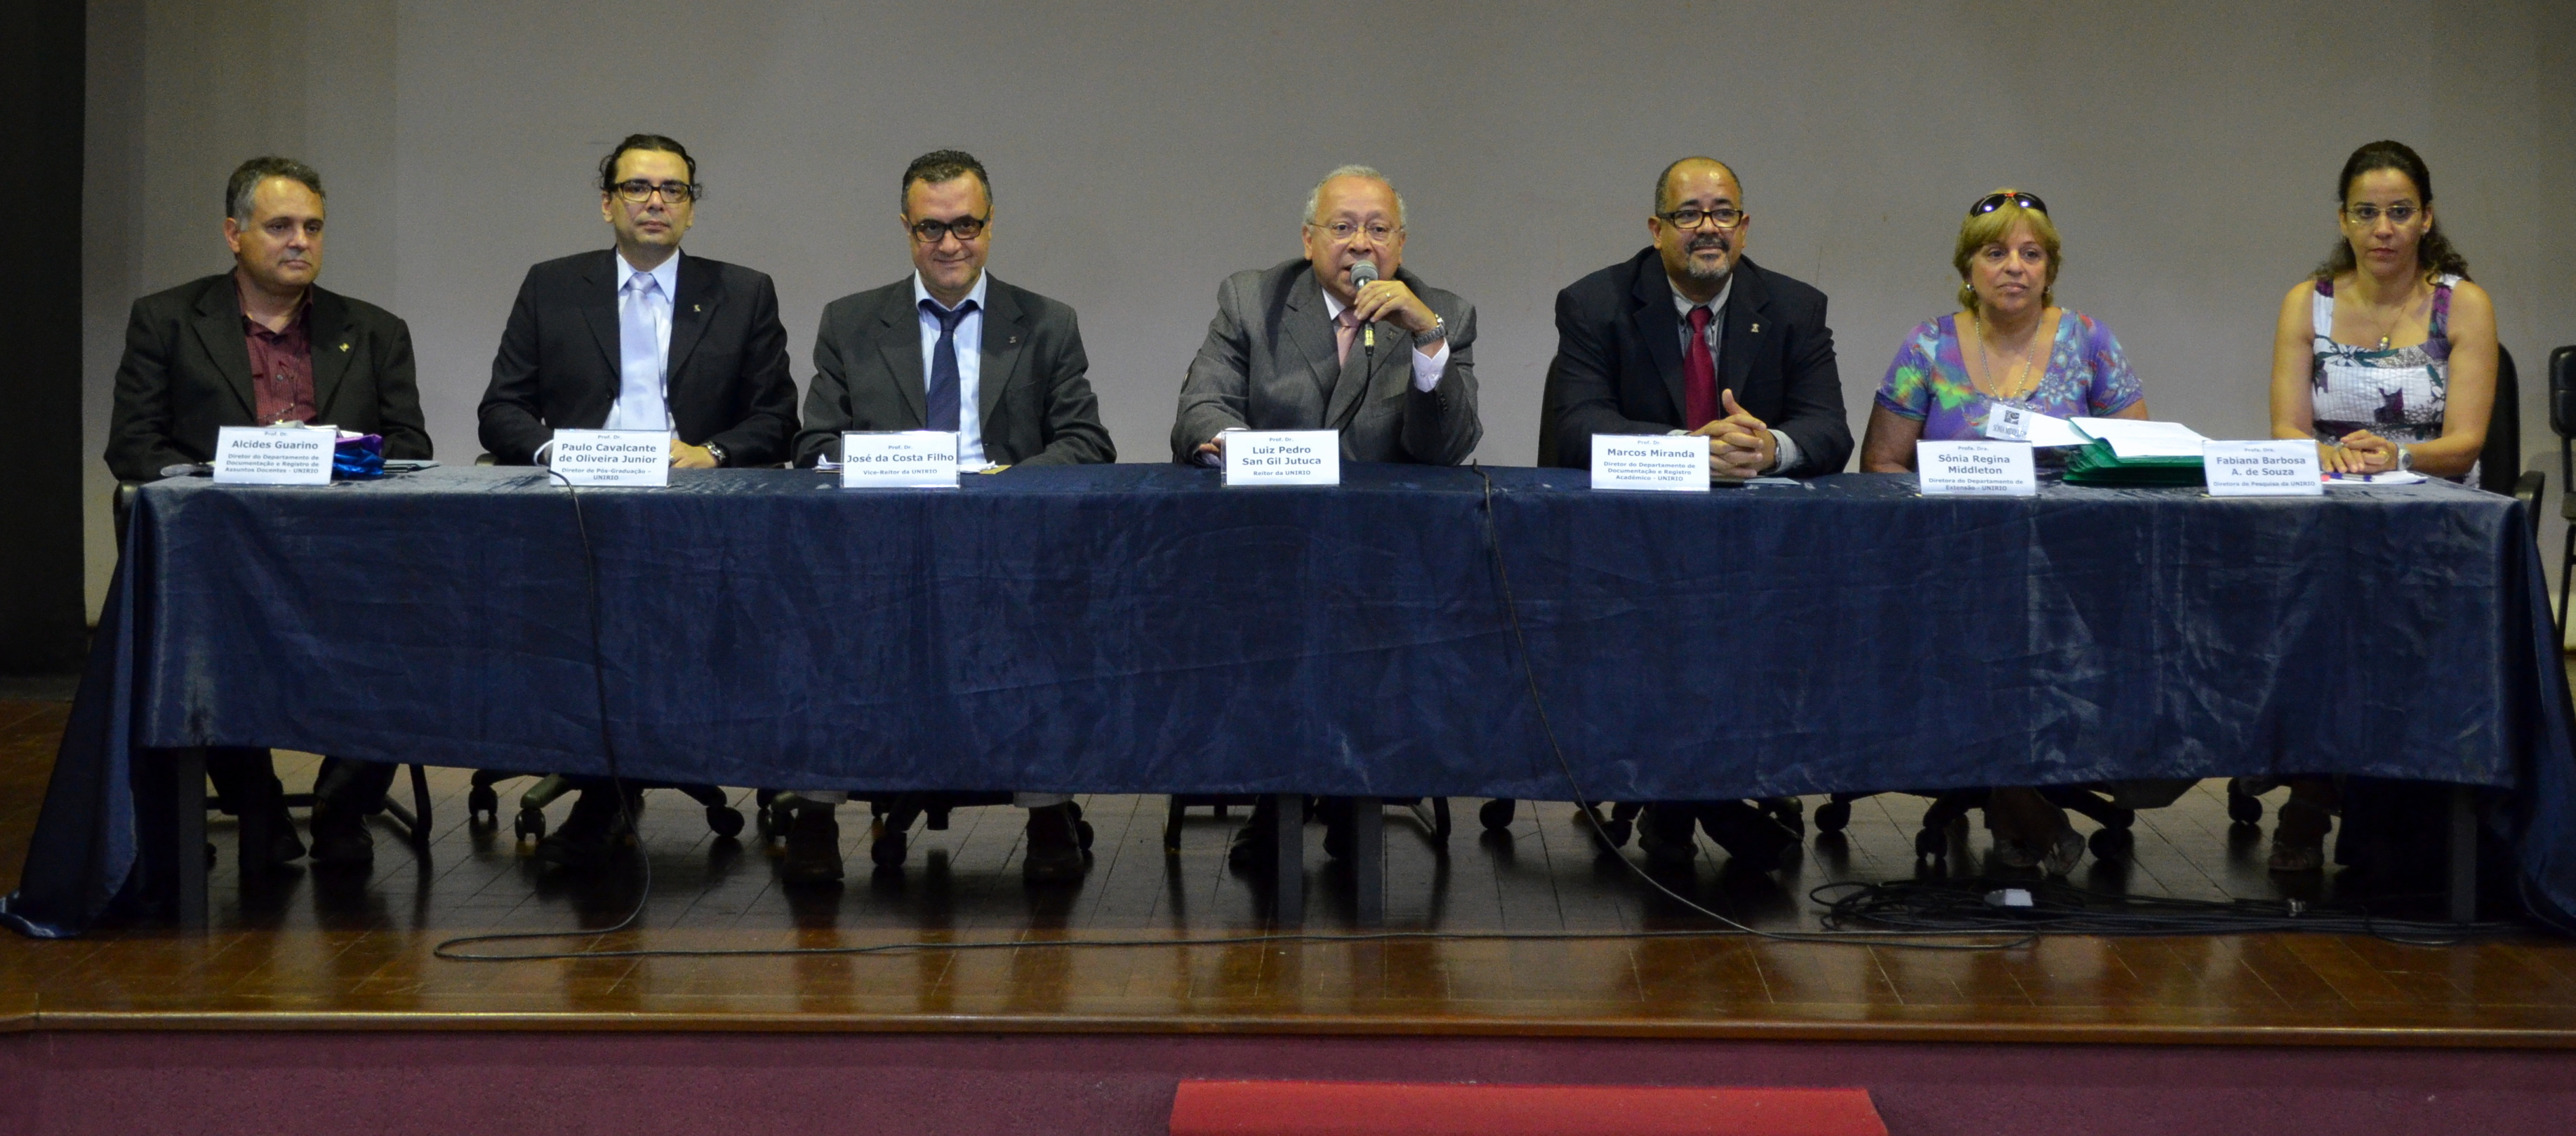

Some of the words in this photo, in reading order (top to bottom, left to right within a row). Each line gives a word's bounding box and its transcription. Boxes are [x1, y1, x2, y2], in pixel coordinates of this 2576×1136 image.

[232, 440, 271, 448] Alcides
[596, 443, 656, 452] Cavalcante
[1651, 449, 1694, 457] Miranda
[847, 454, 871, 462] José
[1939, 454, 1969, 462] Sônia
[1973, 455, 2010, 465] Regina
[1948, 466, 2002, 474] Middleton
